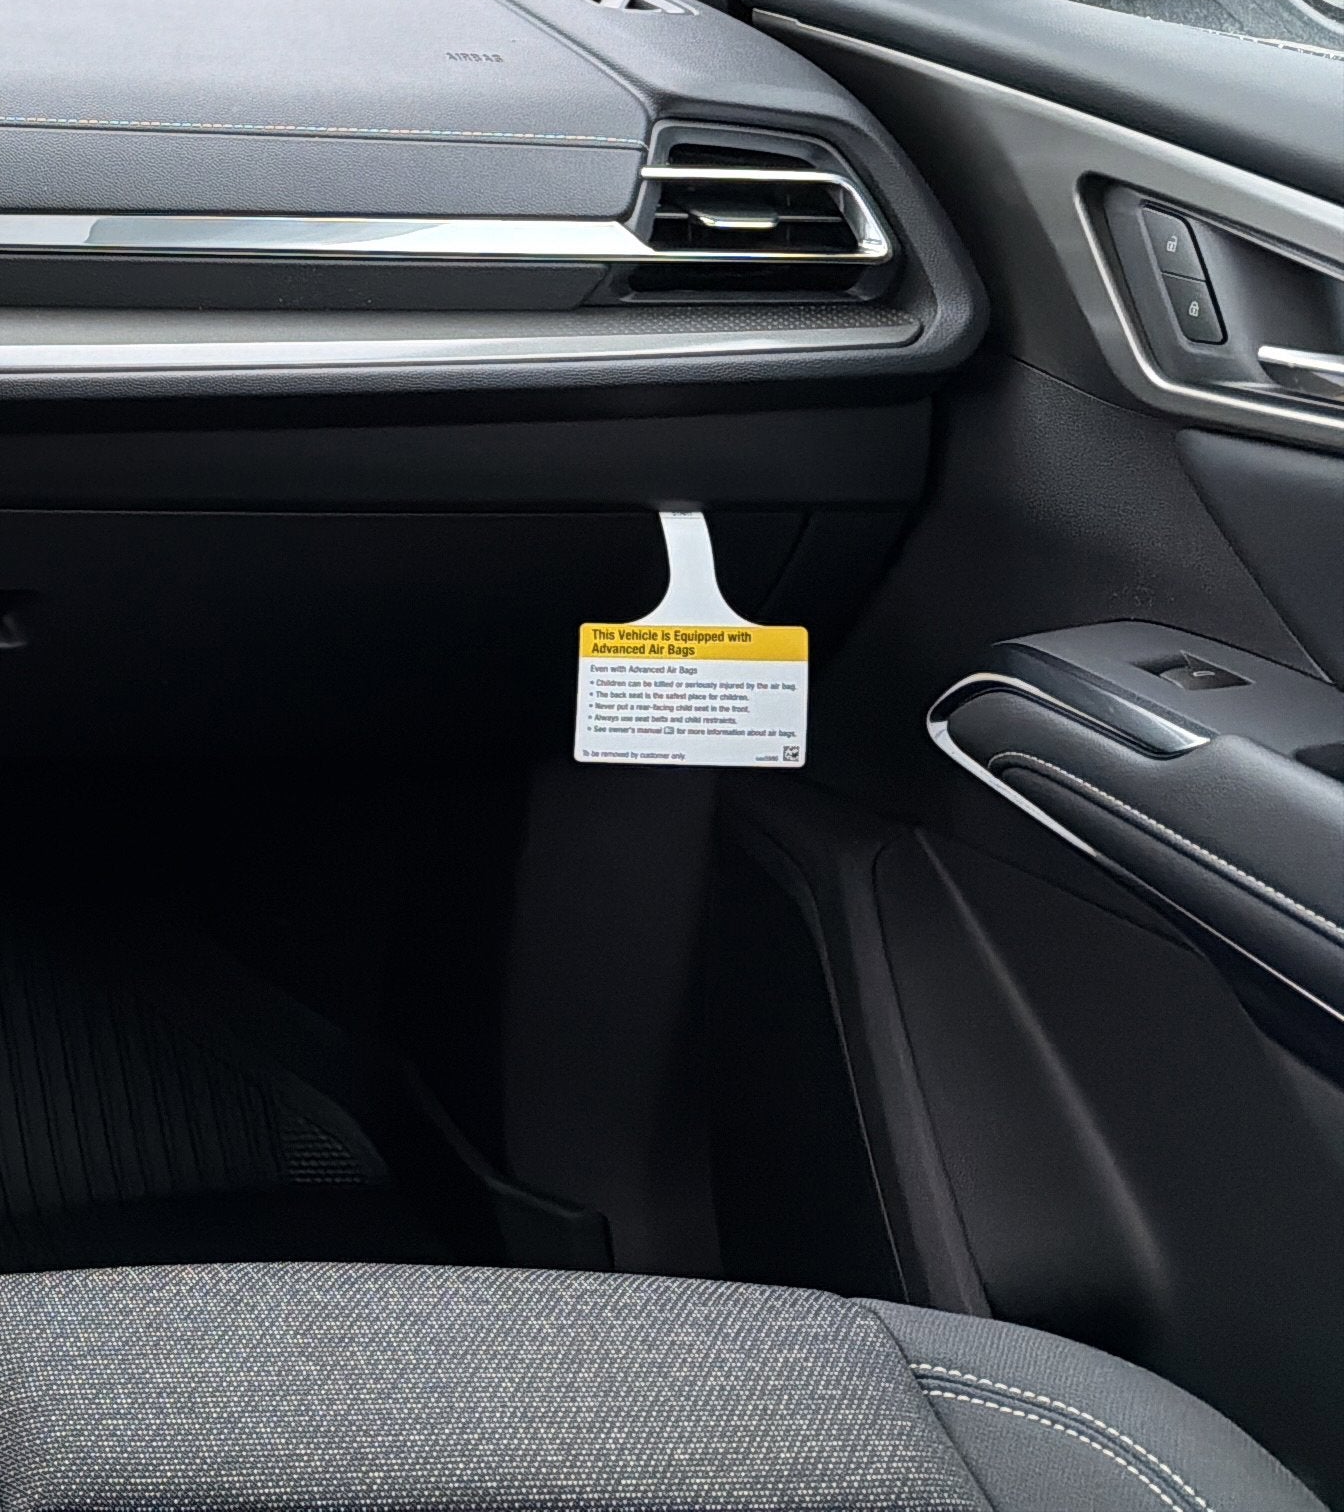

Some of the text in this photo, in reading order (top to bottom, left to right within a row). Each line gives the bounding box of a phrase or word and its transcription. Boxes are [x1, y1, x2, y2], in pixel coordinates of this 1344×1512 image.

[592, 629, 615, 641] This
[618, 629, 658, 642] Vehicle
[674, 630, 724, 644] Equipped
[728, 631, 752, 643] with
[591, 643, 695, 657] Advanced Air Bags
[590, 665, 698, 676] Even with Advanced Air Bags
[596, 679, 626, 687] Children
[643, 680, 652, 688] be
[654, 680, 674, 688] killed
[685, 681, 717, 690] seriously
[719, 682, 744, 690] injured
[746, 682, 755, 691] by
[610, 691, 627, 699] back
[665, 692, 687, 700] safest
[688, 693, 707, 702] place
[709, 693, 718, 701] for
[594, 702, 616, 710] Never
[616, 703, 629, 711] put
[636, 704, 675, 713] rear-facing
[676, 704, 693, 712] child
[719, 705, 731, 713] the
[732, 705, 750, 713] front.
[594, 714, 619, 723] Always
[703, 717, 737, 725] restraints.
[593, 725, 607, 733] See
[676, 727, 686, 735] for
[747, 729, 766, 737] about
